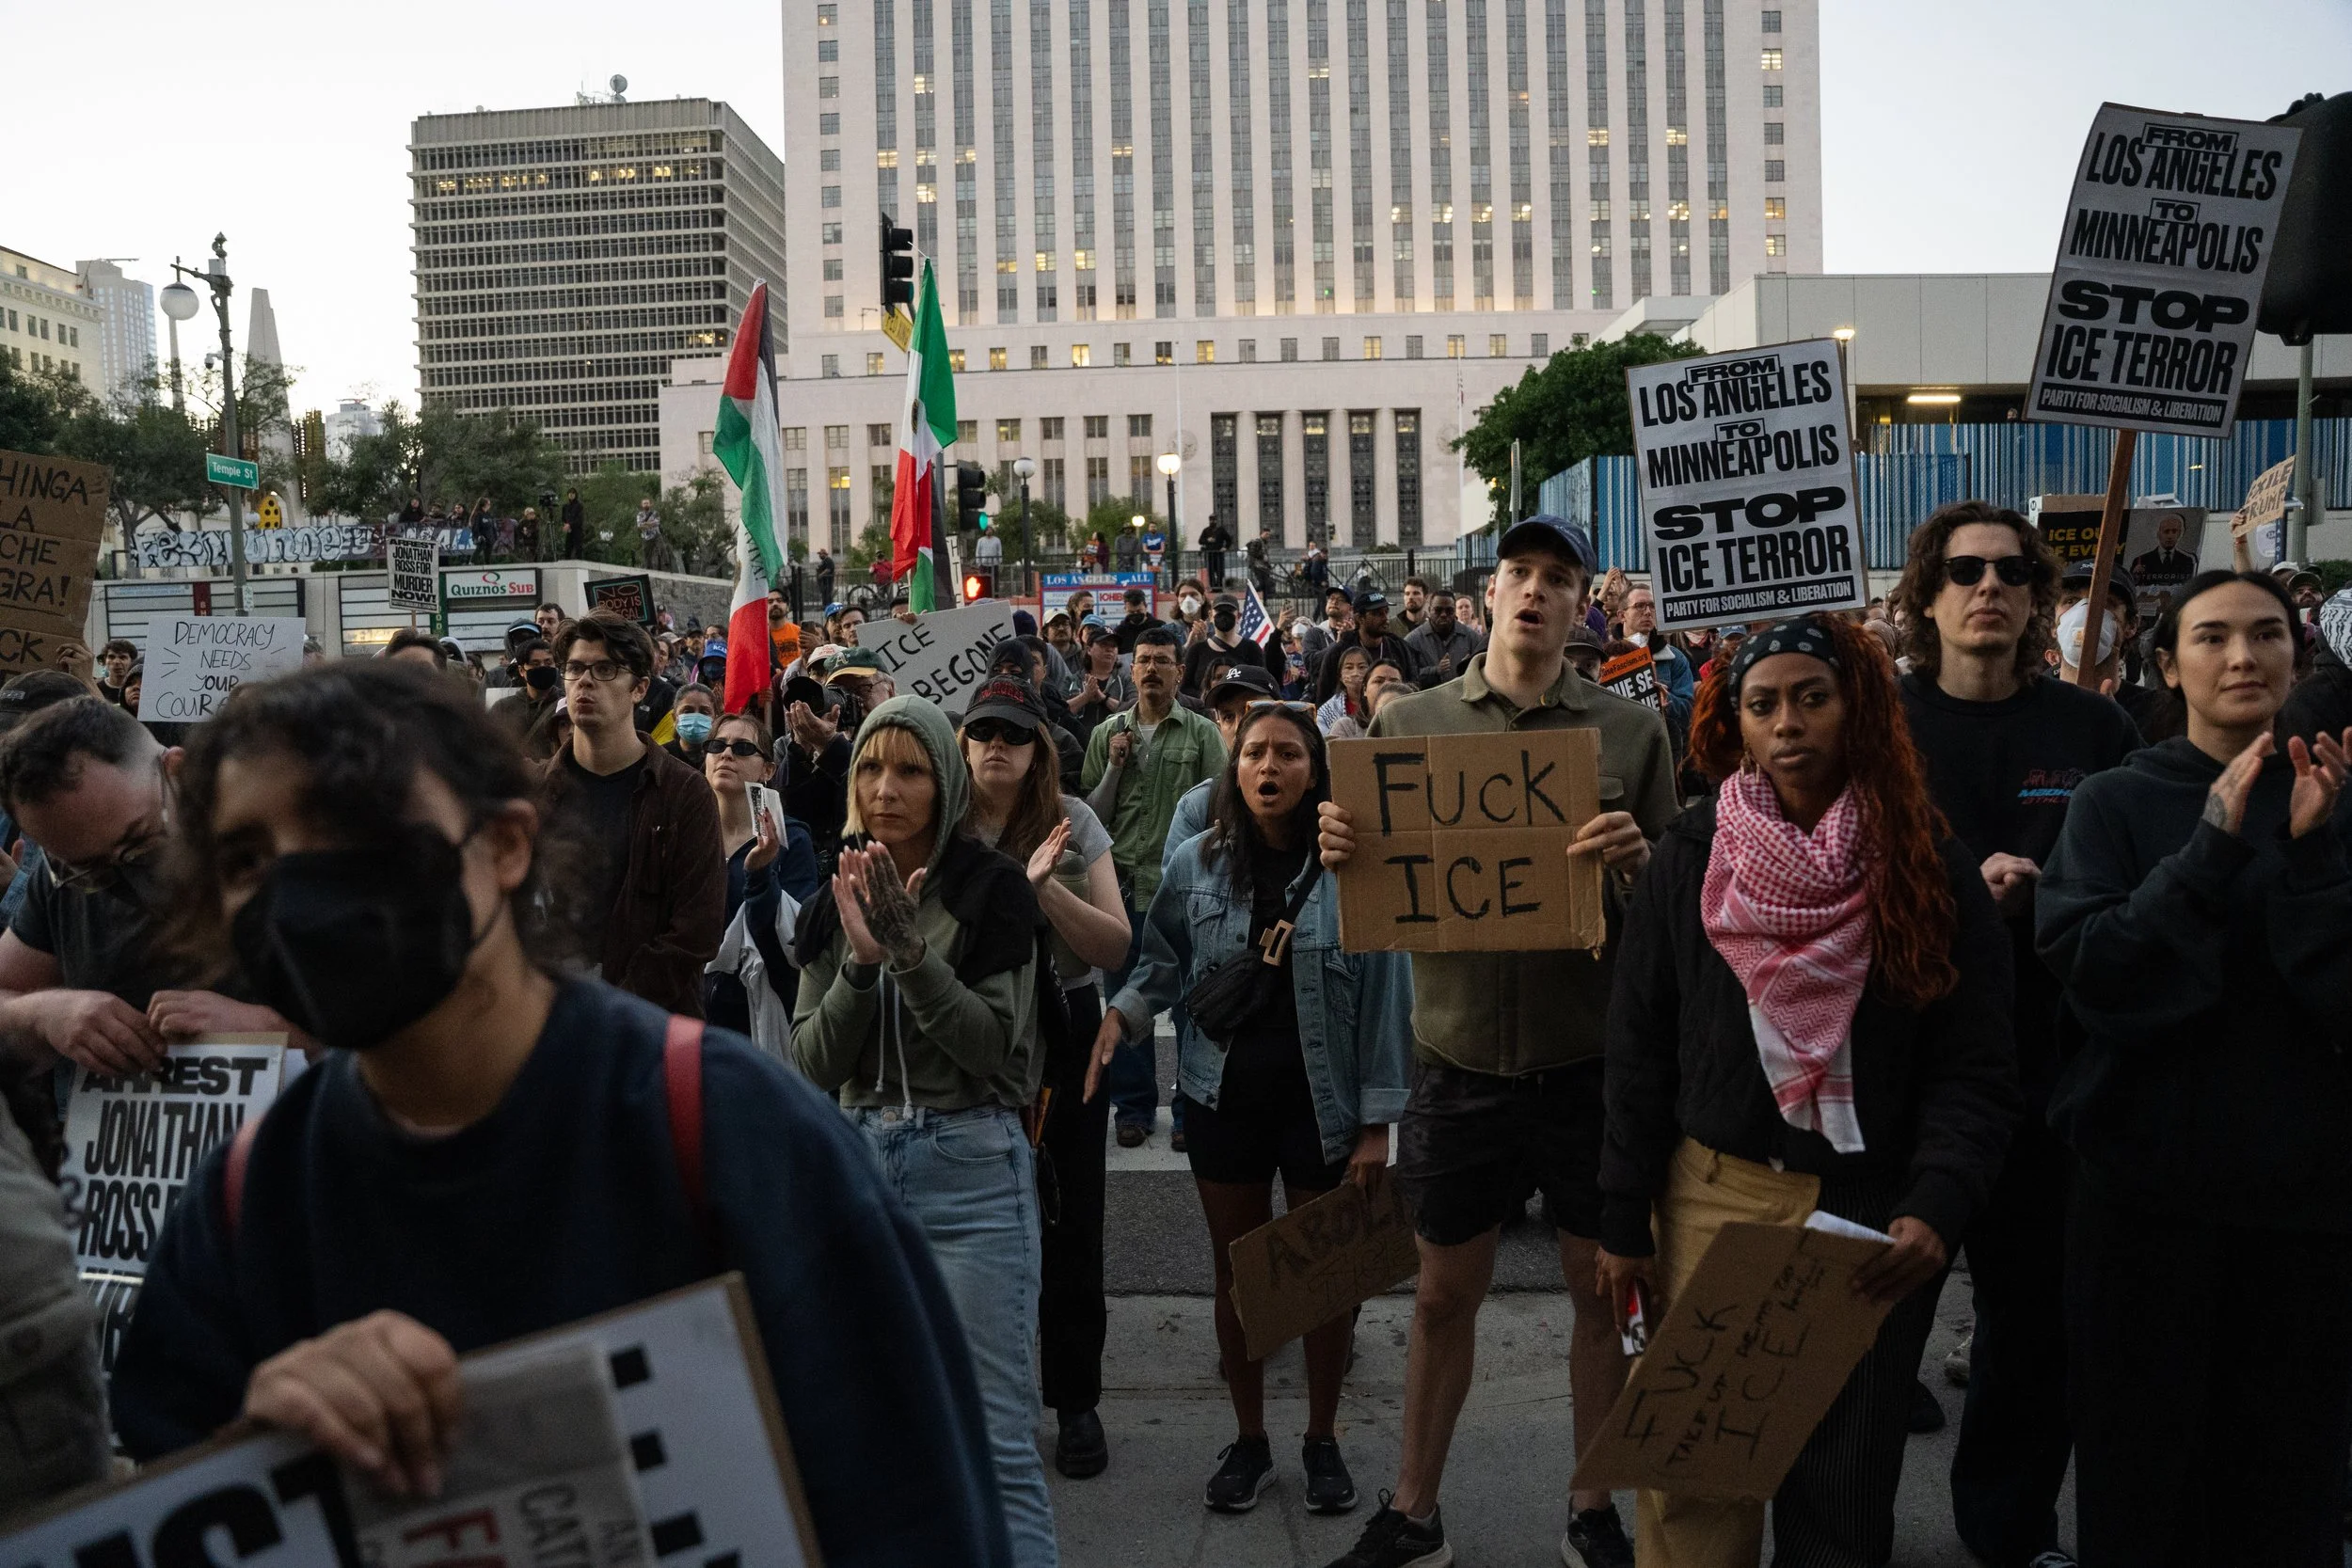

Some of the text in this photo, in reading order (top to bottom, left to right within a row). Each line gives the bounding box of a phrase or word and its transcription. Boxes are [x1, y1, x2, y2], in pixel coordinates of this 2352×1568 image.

[2145, 126, 2234, 150] FROM
[2086, 131, 2282, 201] LOS ANGELES
[2155, 201, 2195, 222] TO
[2069, 208, 2264, 274] MINNEAPOLIS
[2058, 280, 2249, 333] STOP
[1690, 357, 1776, 383] FROM
[2045, 324, 2238, 395] ICE TERROR
[1639, 360, 1832, 427] LOS ANGELES
[2041, 388, 2223, 423] PARTY FOR SOCIALISM & LIBERATION
[1719, 422, 1761, 439] TO
[1646, 424, 1839, 488] MINNEAPOLIS
[212, 462, 253, 479] Temple St
[1653, 486, 1846, 540] STOP
[389, 538, 437, 549] ARREST
[2048, 527, 2102, 542] ICE OU
[392, 546, 433, 562] JONATHAN
[1658, 525, 1851, 594] ICE TERROR
[2071, 543, 2125, 558] EVEY
[395, 559, 431, 575] ROSS FOR
[1071, 573, 1118, 585] ANGELES
[391, 590, 437, 604] NOW!
[394, 574, 433, 594] MURDER
[596, 584, 639, 598] NO
[630, 595, 641, 607] IS
[1666, 580, 1851, 618] PARTY FOR SOCIALISM & LIBERATION
[175, 621, 275, 650] DEMOCRACY
[876, 623, 935, 673] ICE
[200, 649, 251, 671] NEEDS
[911, 623, 1011, 705] BEGONE
[1226, 668, 1242, 680] LA
[1636, 669, 1654, 693] SE
[156, 691, 226, 719] COUR
[1373, 750, 1567, 837] FUCK
[1383, 854, 1541, 924] ICE
[77, 1179, 161, 1262] ROSS
[1625, 1305, 1739, 1449] FUCK
[1714, 1323, 1812, 1461] ICE
